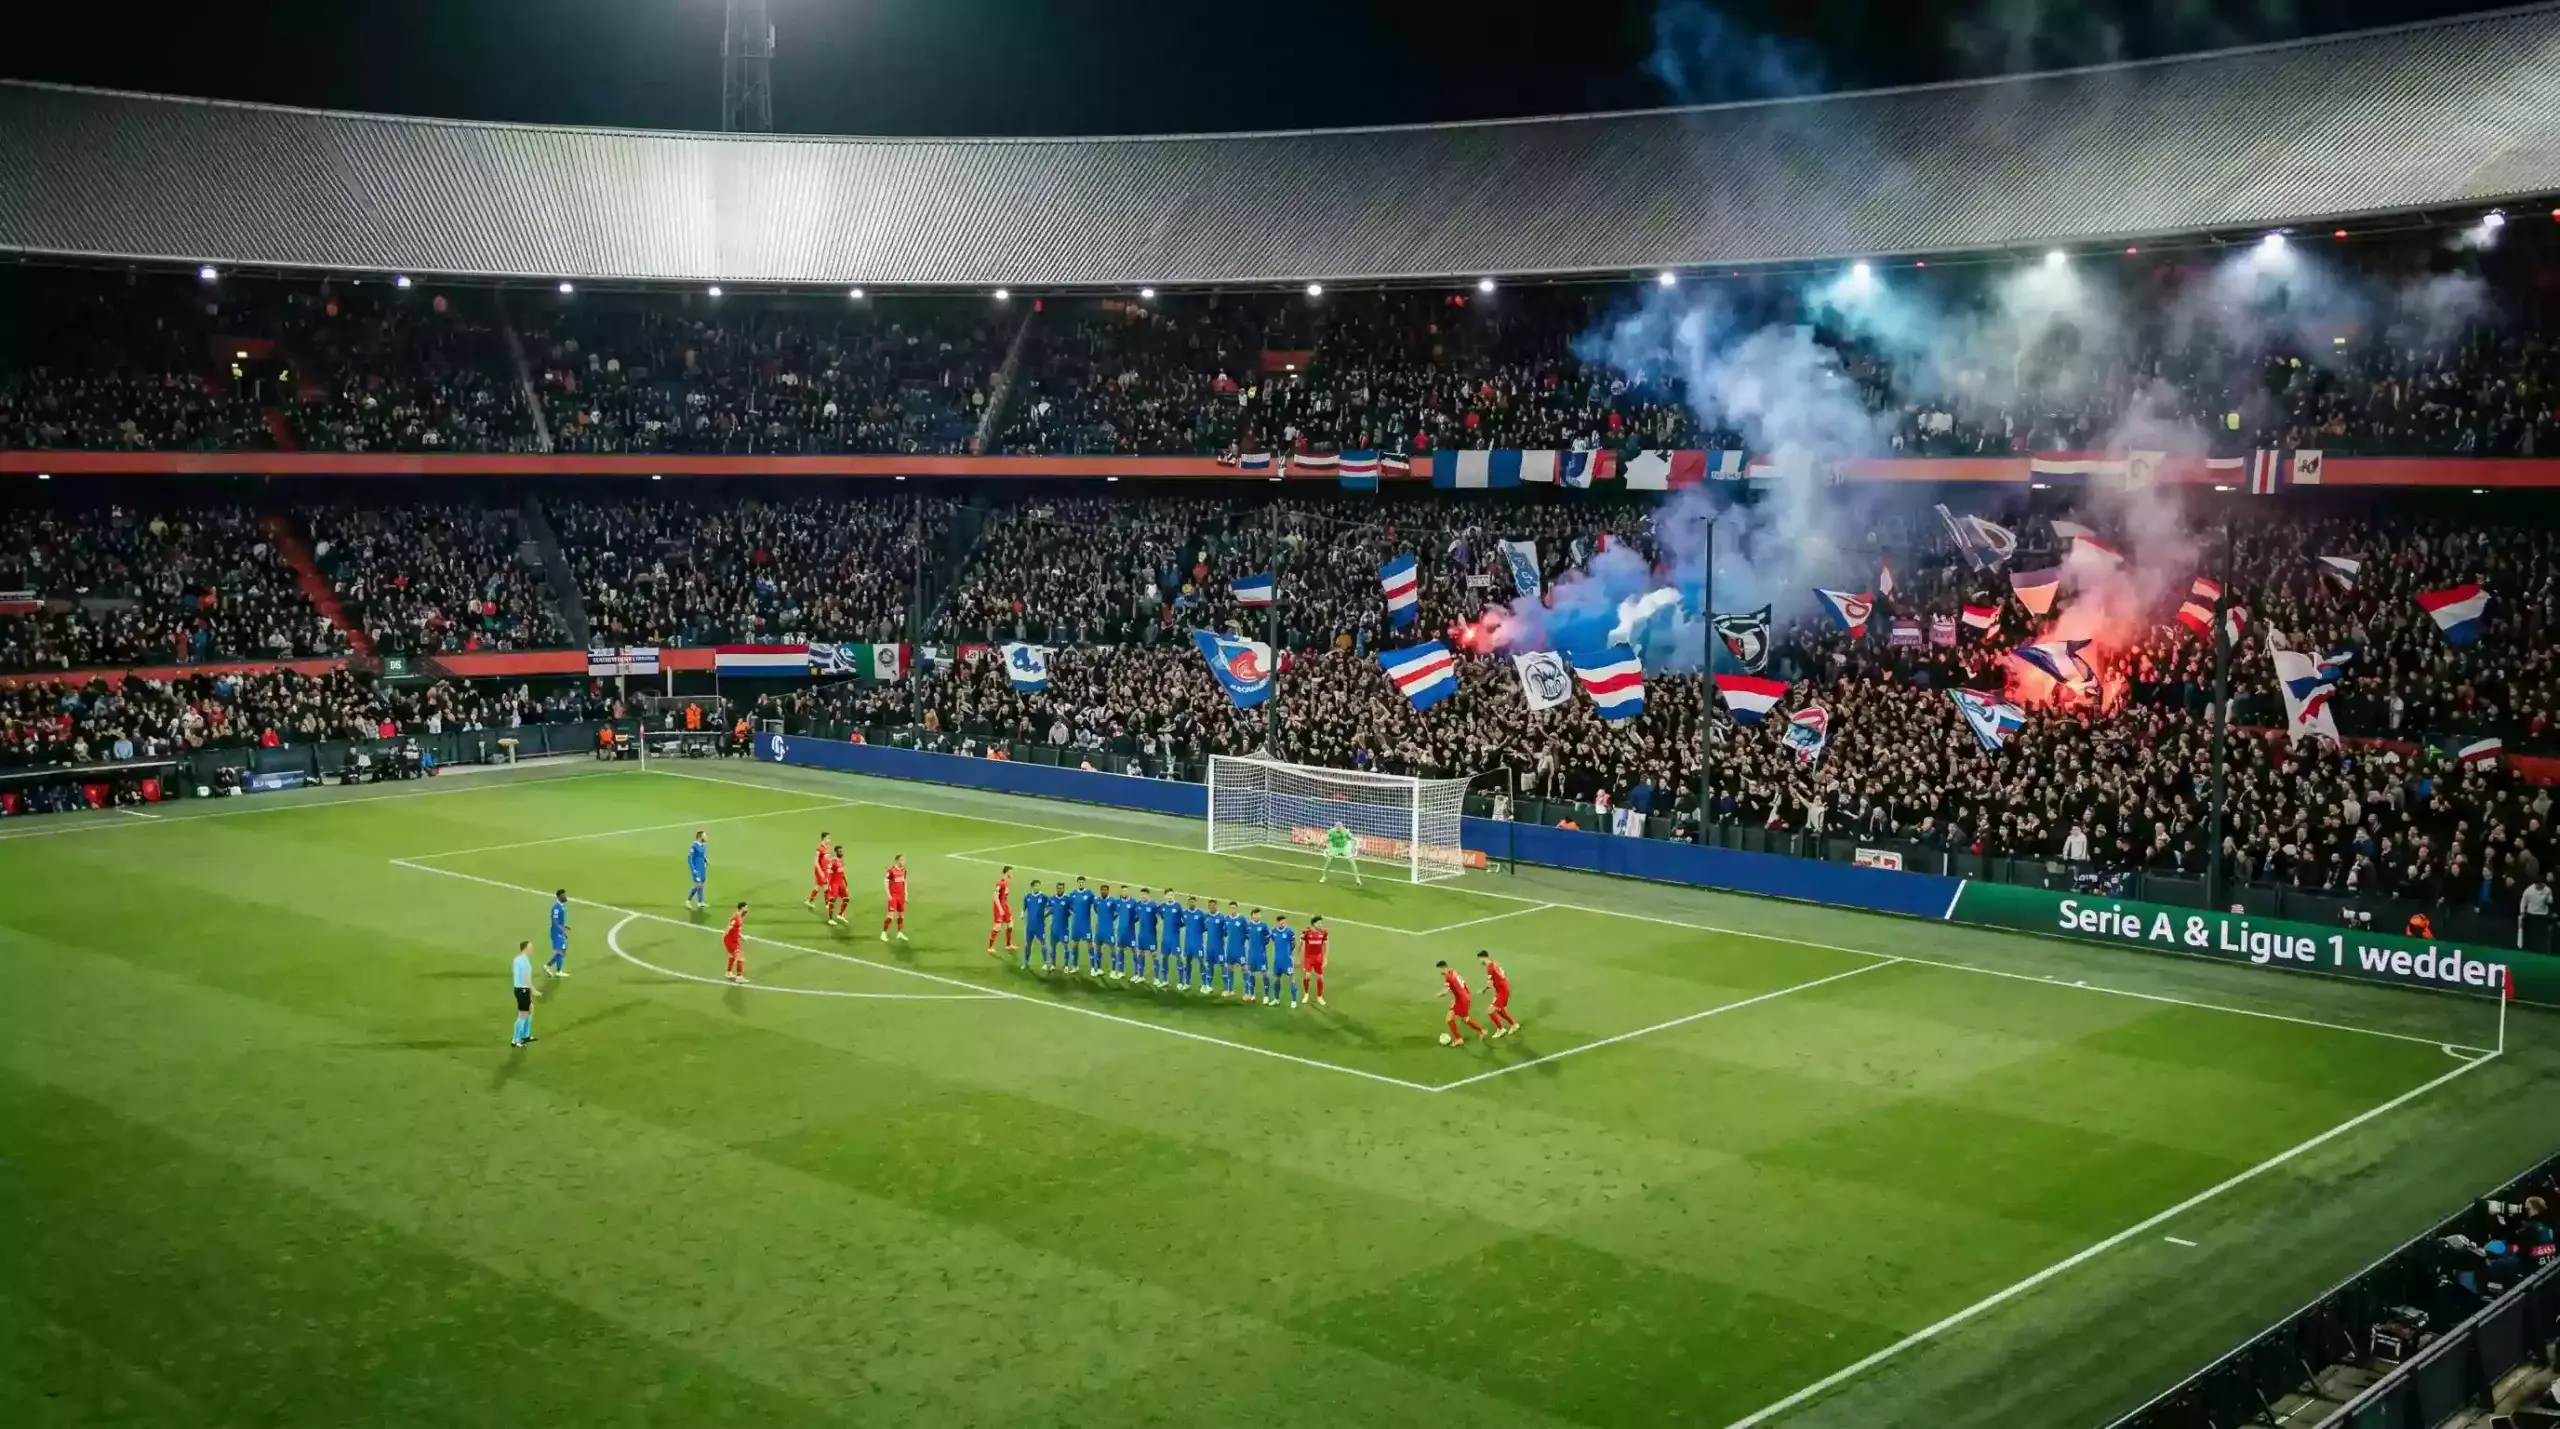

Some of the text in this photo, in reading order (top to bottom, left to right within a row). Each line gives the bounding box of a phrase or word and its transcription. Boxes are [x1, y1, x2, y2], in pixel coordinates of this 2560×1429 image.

[2059, 899, 2507, 988] Serie A & Ligue 1 wedden
